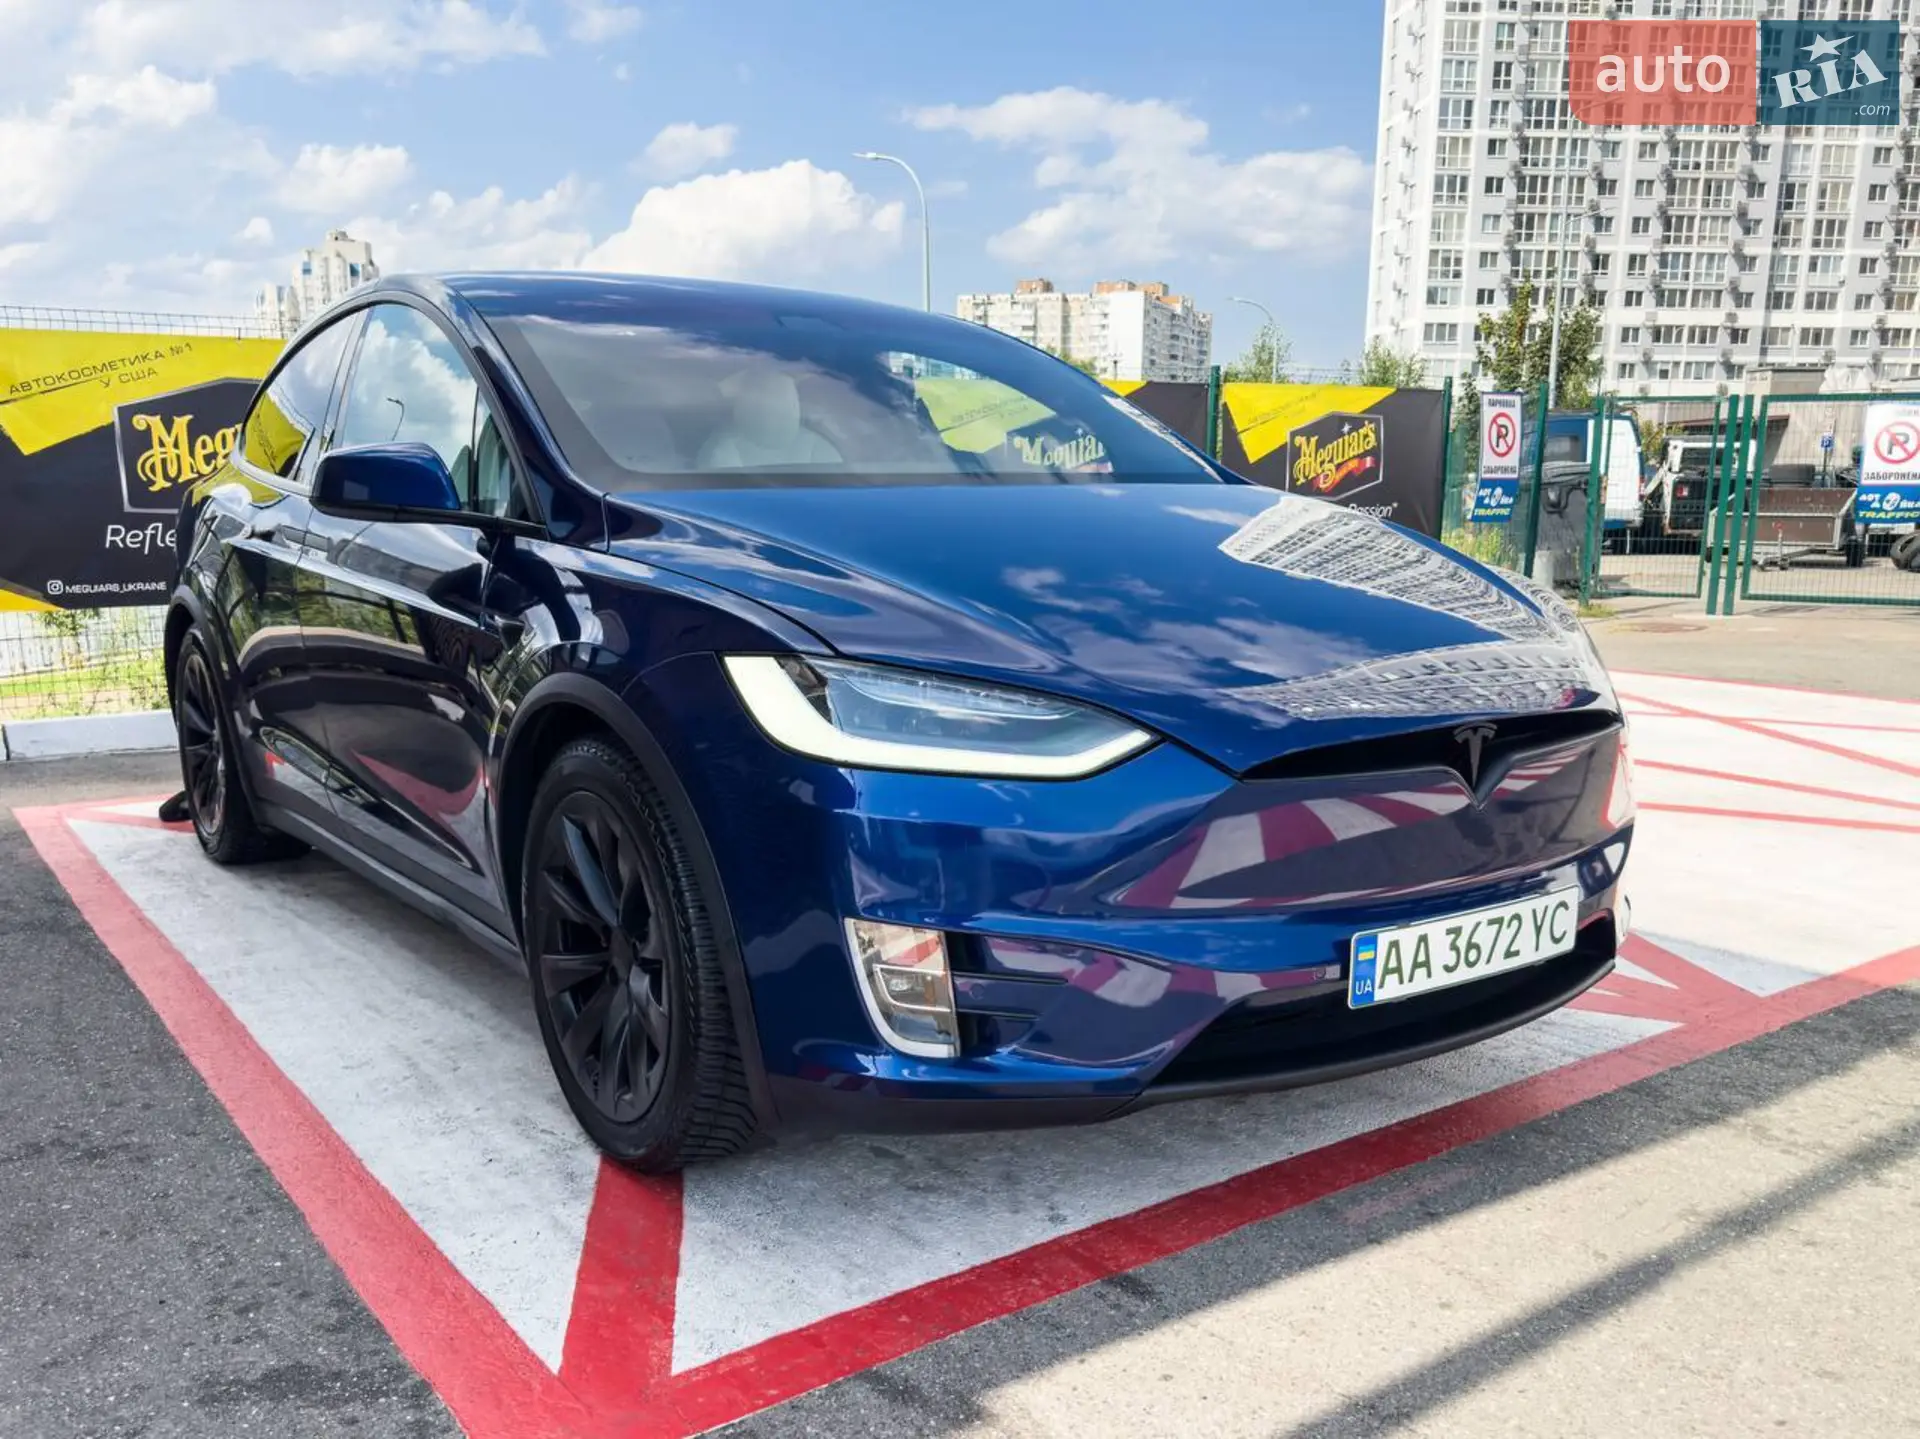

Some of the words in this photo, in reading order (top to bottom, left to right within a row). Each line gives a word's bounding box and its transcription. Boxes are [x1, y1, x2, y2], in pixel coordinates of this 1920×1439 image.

[9, 350, 165, 395] АВТОКОСМЕТИКА
[119, 367, 158, 384] США
[132, 414, 243, 492] Meg
[65, 581, 167, 594] MEGUIARS_UKRAINE
[1378, 932, 1432, 989] AA
[1442, 912, 1523, 974] 3672
[1532, 900, 1570, 952] YC
[1355, 978, 1373, 995] UA
